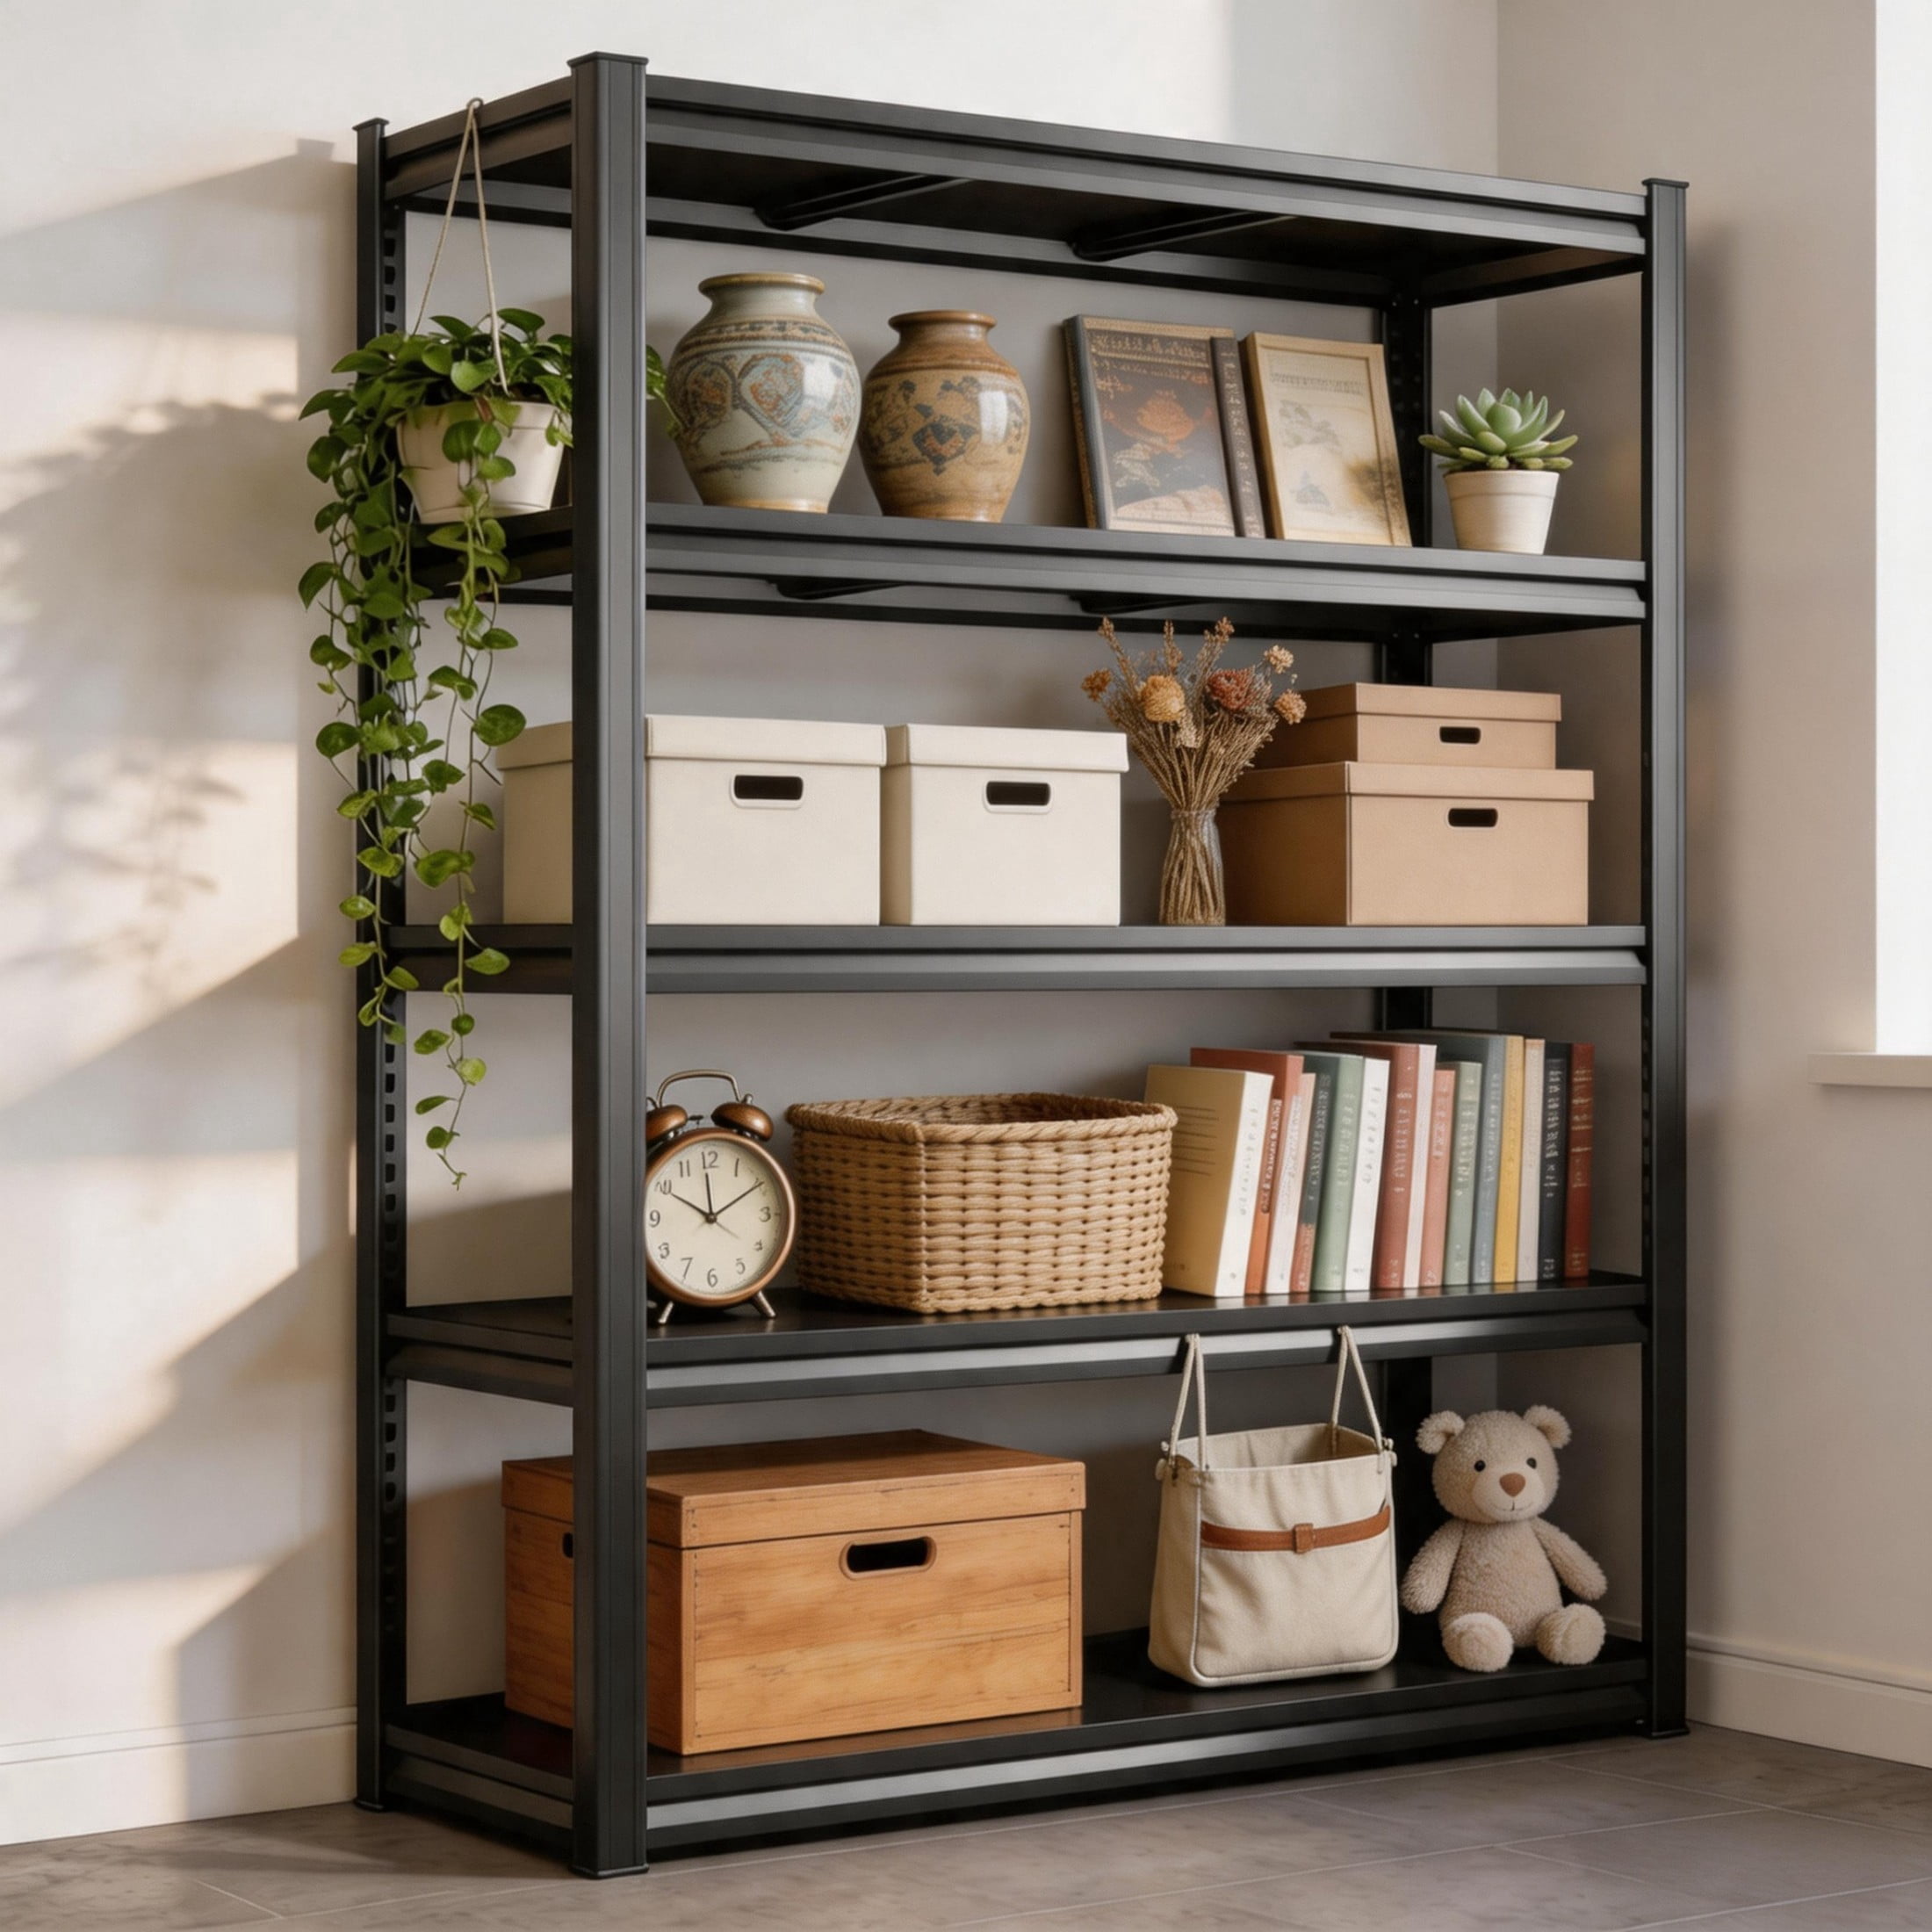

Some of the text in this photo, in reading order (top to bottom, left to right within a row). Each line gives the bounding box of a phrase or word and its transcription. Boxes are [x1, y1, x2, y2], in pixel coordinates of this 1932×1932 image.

[679, 1159, 691, 1178] 11
[701, 1150, 720, 1170] 12
[649, 1209, 661, 1228] 9
[759, 1206, 772, 1222] 3
[681, 1257, 695, 1280] 7
[735, 1258, 746, 1275] 5
[707, 1267, 718, 1287] 6
